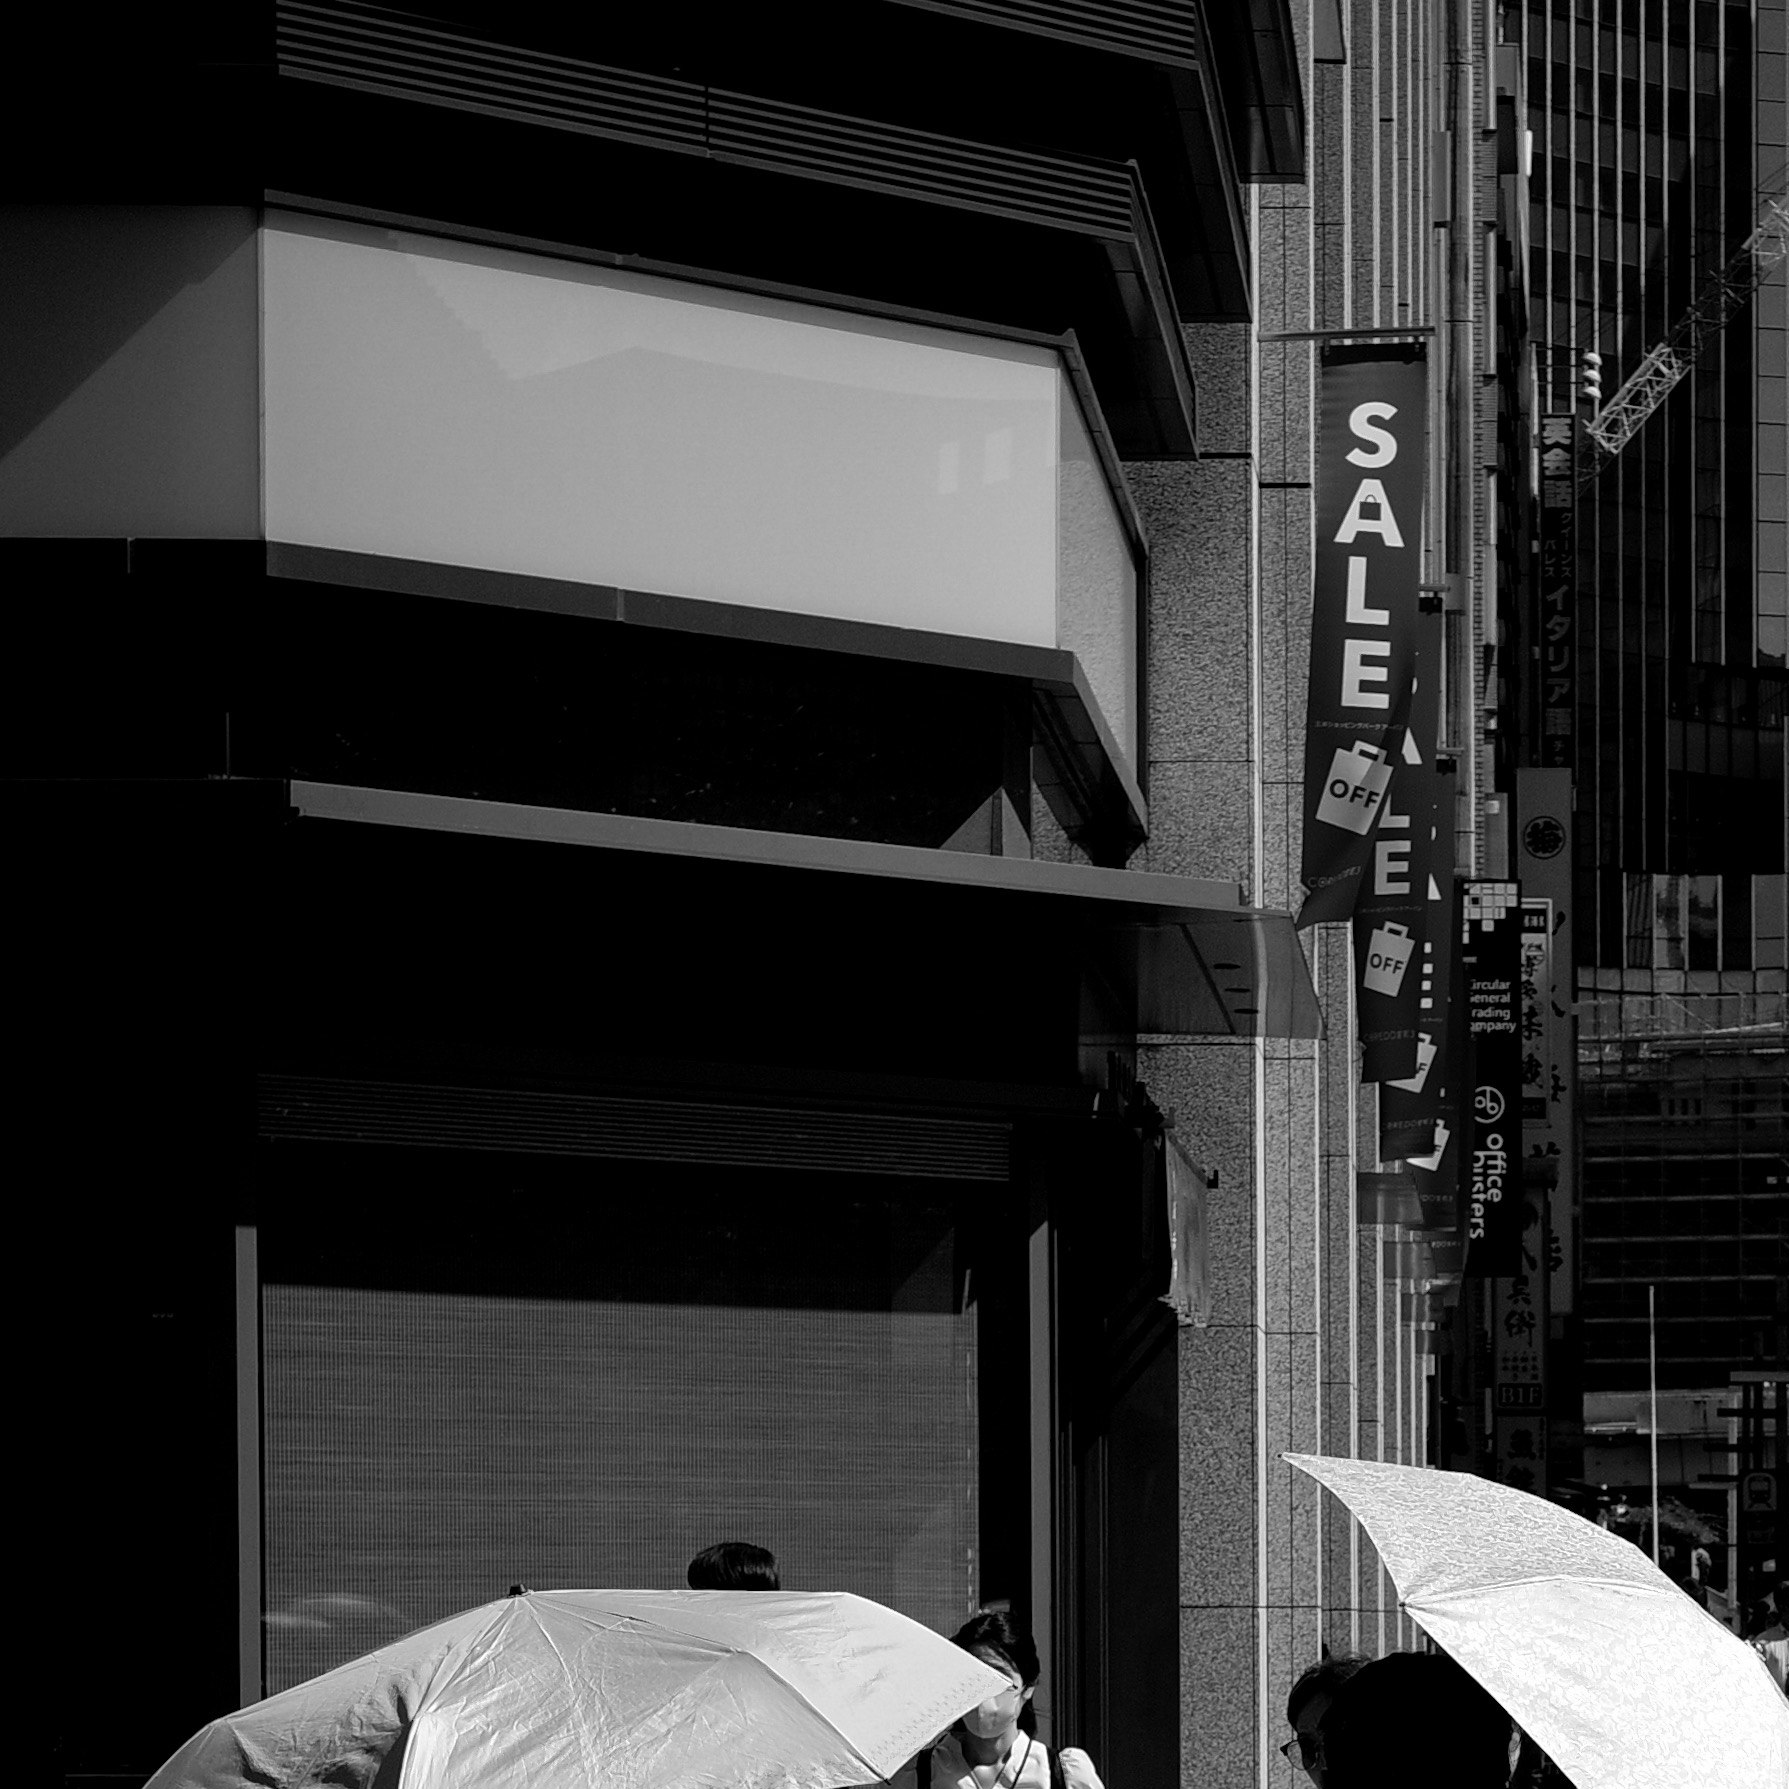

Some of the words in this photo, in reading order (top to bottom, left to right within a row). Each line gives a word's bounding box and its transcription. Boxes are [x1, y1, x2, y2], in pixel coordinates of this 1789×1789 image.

[1333, 401, 1404, 708] SALE
[1329, 778, 1379, 811] OFF
[1369, 952, 1405, 975] OFF
[1470, 1006, 1511, 1021] rading
[1486, 1133, 1507, 1203] office
[1469, 1150, 1487, 1240] busters
[1500, 1385, 1540, 1404] B1F
